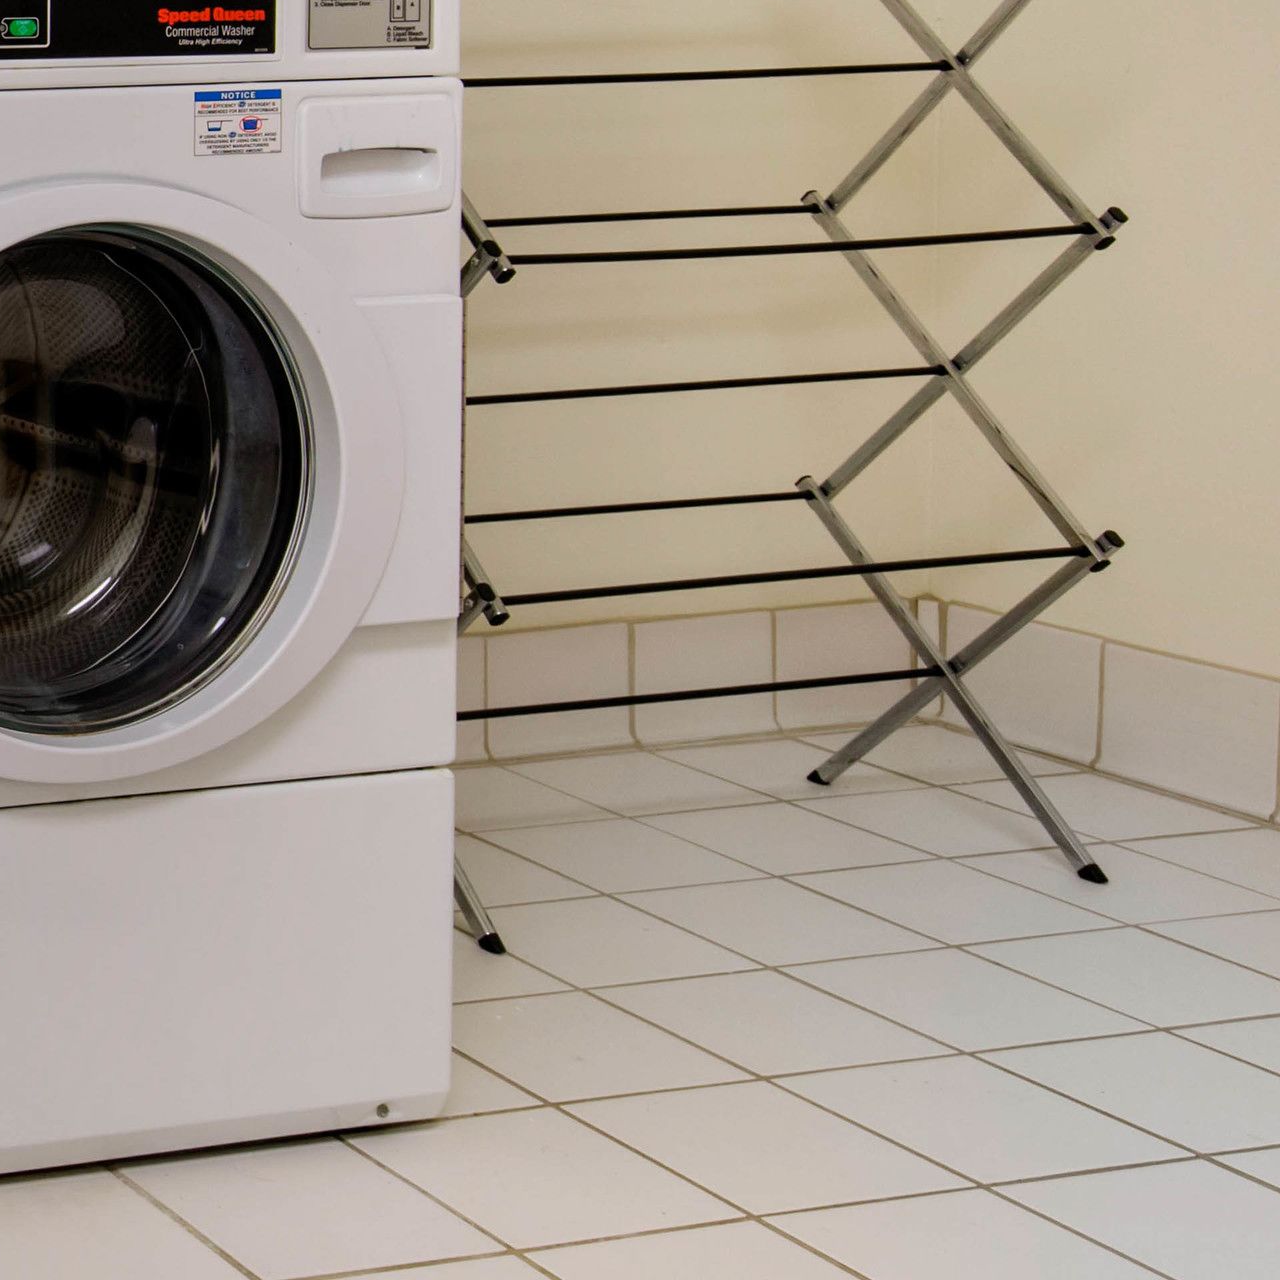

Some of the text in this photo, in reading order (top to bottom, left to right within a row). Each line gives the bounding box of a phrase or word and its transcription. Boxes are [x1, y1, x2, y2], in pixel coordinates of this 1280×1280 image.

[158, 7, 266, 26] Speed Queen
[165, 24, 256, 38] Commercial Washer
[195, 38, 210, 47] High
[211, 38, 243, 46] Efficiency
[220, 91, 257, 100] NOTICE
